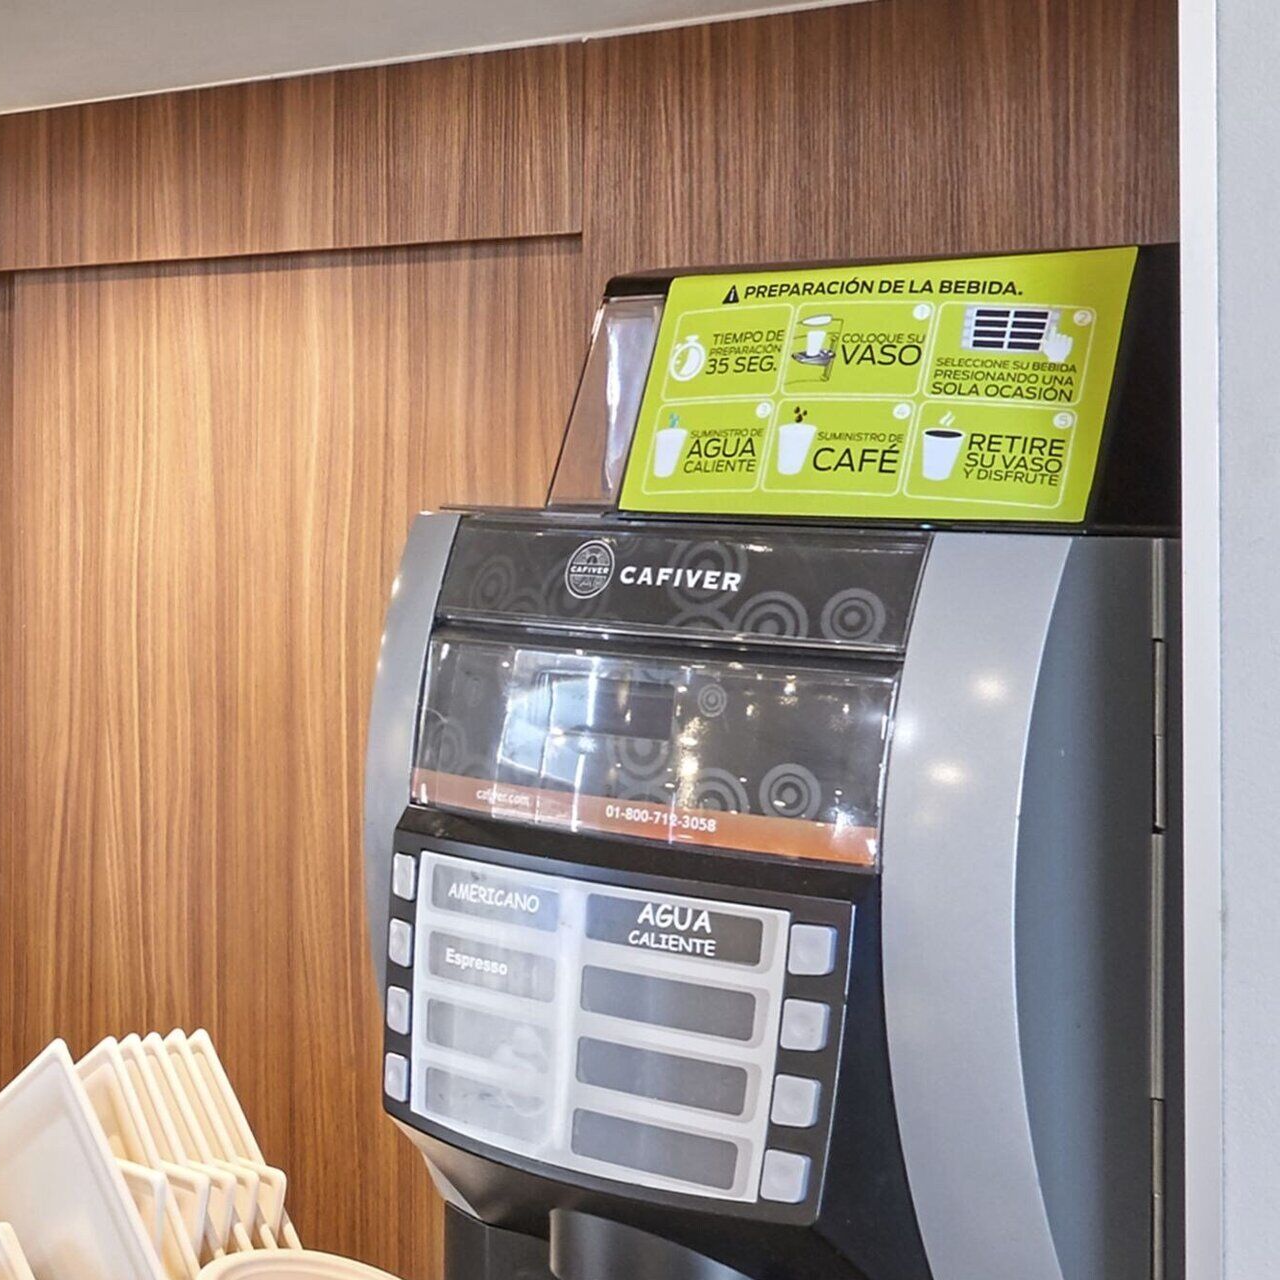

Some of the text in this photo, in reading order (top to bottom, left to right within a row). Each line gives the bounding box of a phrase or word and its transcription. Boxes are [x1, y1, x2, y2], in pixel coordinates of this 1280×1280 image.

[743, 277, 1024, 299] PREPARACIÓN DE LA BEBIDA.
[713, 330, 785, 346] TIEMPO DE
[842, 333, 926, 345] COLOQUE SU
[708, 343, 783, 357] PREPARACIÓN
[841, 344, 922, 366] VASO
[705, 356, 777, 375] 35 SEG.
[936, 357, 1077, 374] SELECCIONE SU BEBIDA
[933, 369, 1075, 387] PRESIONANDO UNA
[930, 382, 1074, 403] SOLA OCASIÓN
[690, 428, 764, 439] SUMINISTRO DE
[817, 431, 905, 443] SUMINISTRO DE
[686, 438, 756, 460] AGUA
[968, 433, 1067, 458] RETIRE
[683, 459, 757, 474] CALIENTE
[812, 444, 901, 474] CAFÉ
[964, 452, 1064, 475] SU VASO
[963, 468, 1060, 487] Y DISFRUTE
[570, 565, 610, 575] CAFIVER
[619, 566, 743, 593] CAFIVER
[448, 882, 540, 915] AMERICANO
[637, 902, 713, 934] AGUA
[628, 929, 717, 957] CALIENTE
[444, 947, 509, 977] Espresso
